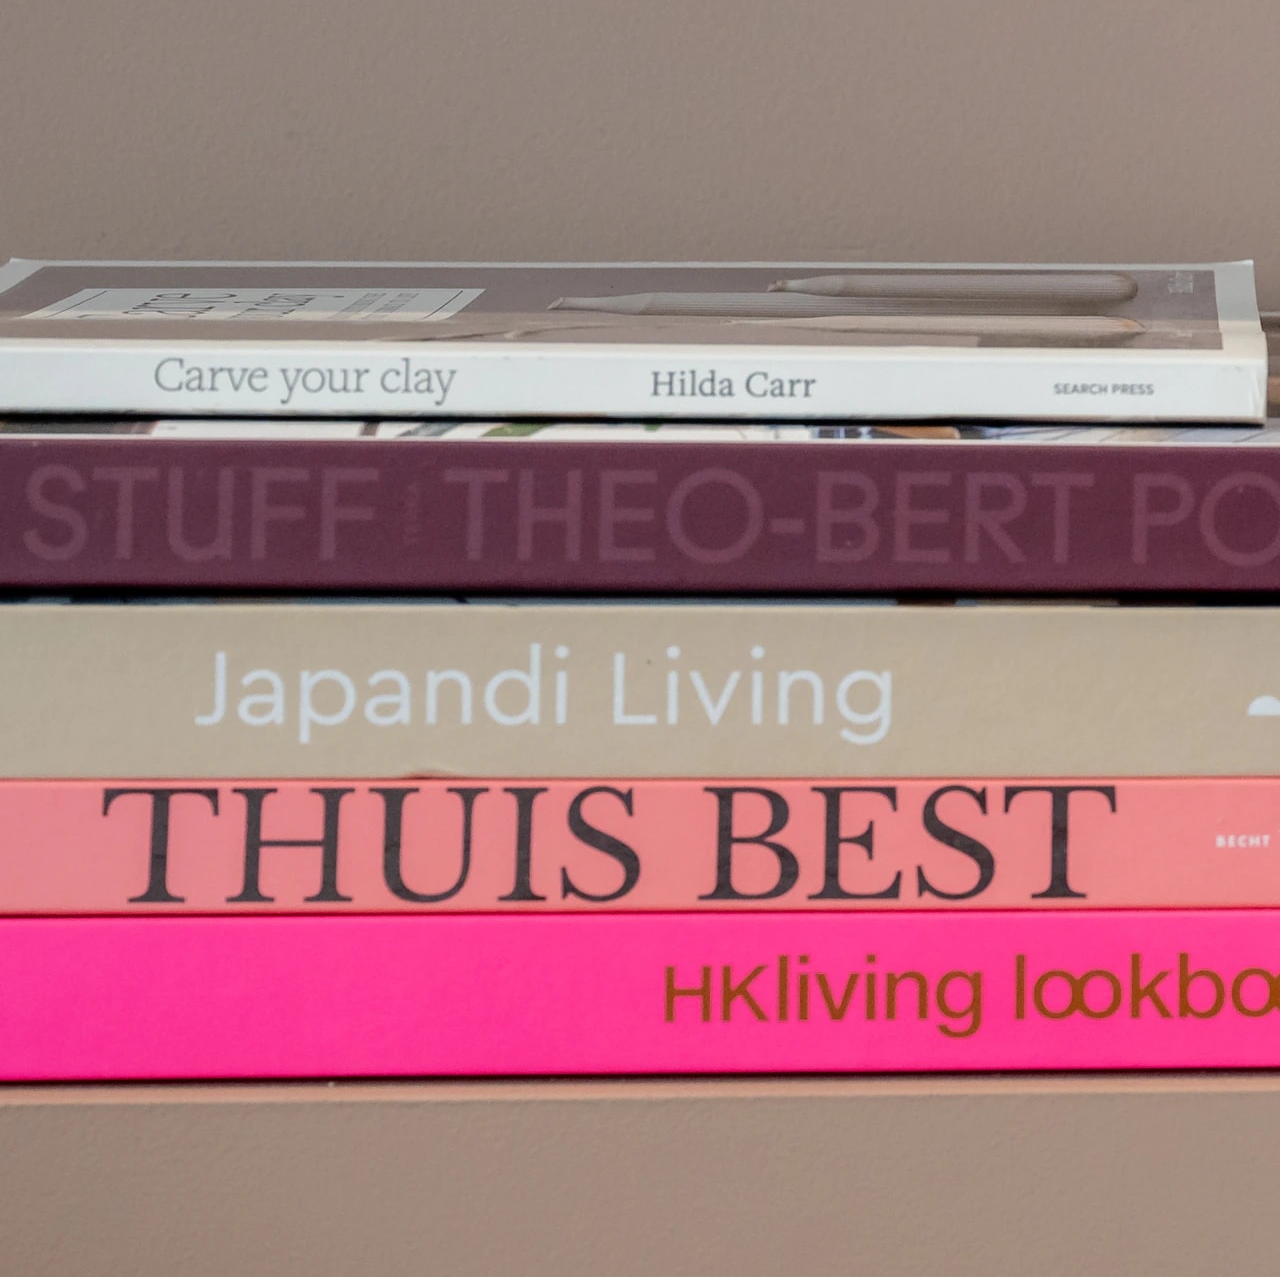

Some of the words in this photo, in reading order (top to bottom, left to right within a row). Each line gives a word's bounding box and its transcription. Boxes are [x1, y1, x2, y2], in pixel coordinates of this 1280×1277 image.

[153, 357, 269, 394] Carve
[281, 367, 375, 404] your
[380, 358, 457, 405] clay
[651, 370, 735, 398] Hilda
[745, 372, 817, 399] Carr
[1053, 383, 1109, 396] SEARCH
[1112, 383, 1155, 396] PRESS
[23, 465, 380, 562] STUFF
[443, 467, 1094, 564] THEO-BERT
[195, 643, 569, 745] Japandi
[612, 645, 893, 745] Living
[102, 785, 642, 904] THUIS
[696, 784, 1117, 901] BEST
[1214, 833, 1271, 848] BECHT
[663, 953, 983, 1039] HKliving
